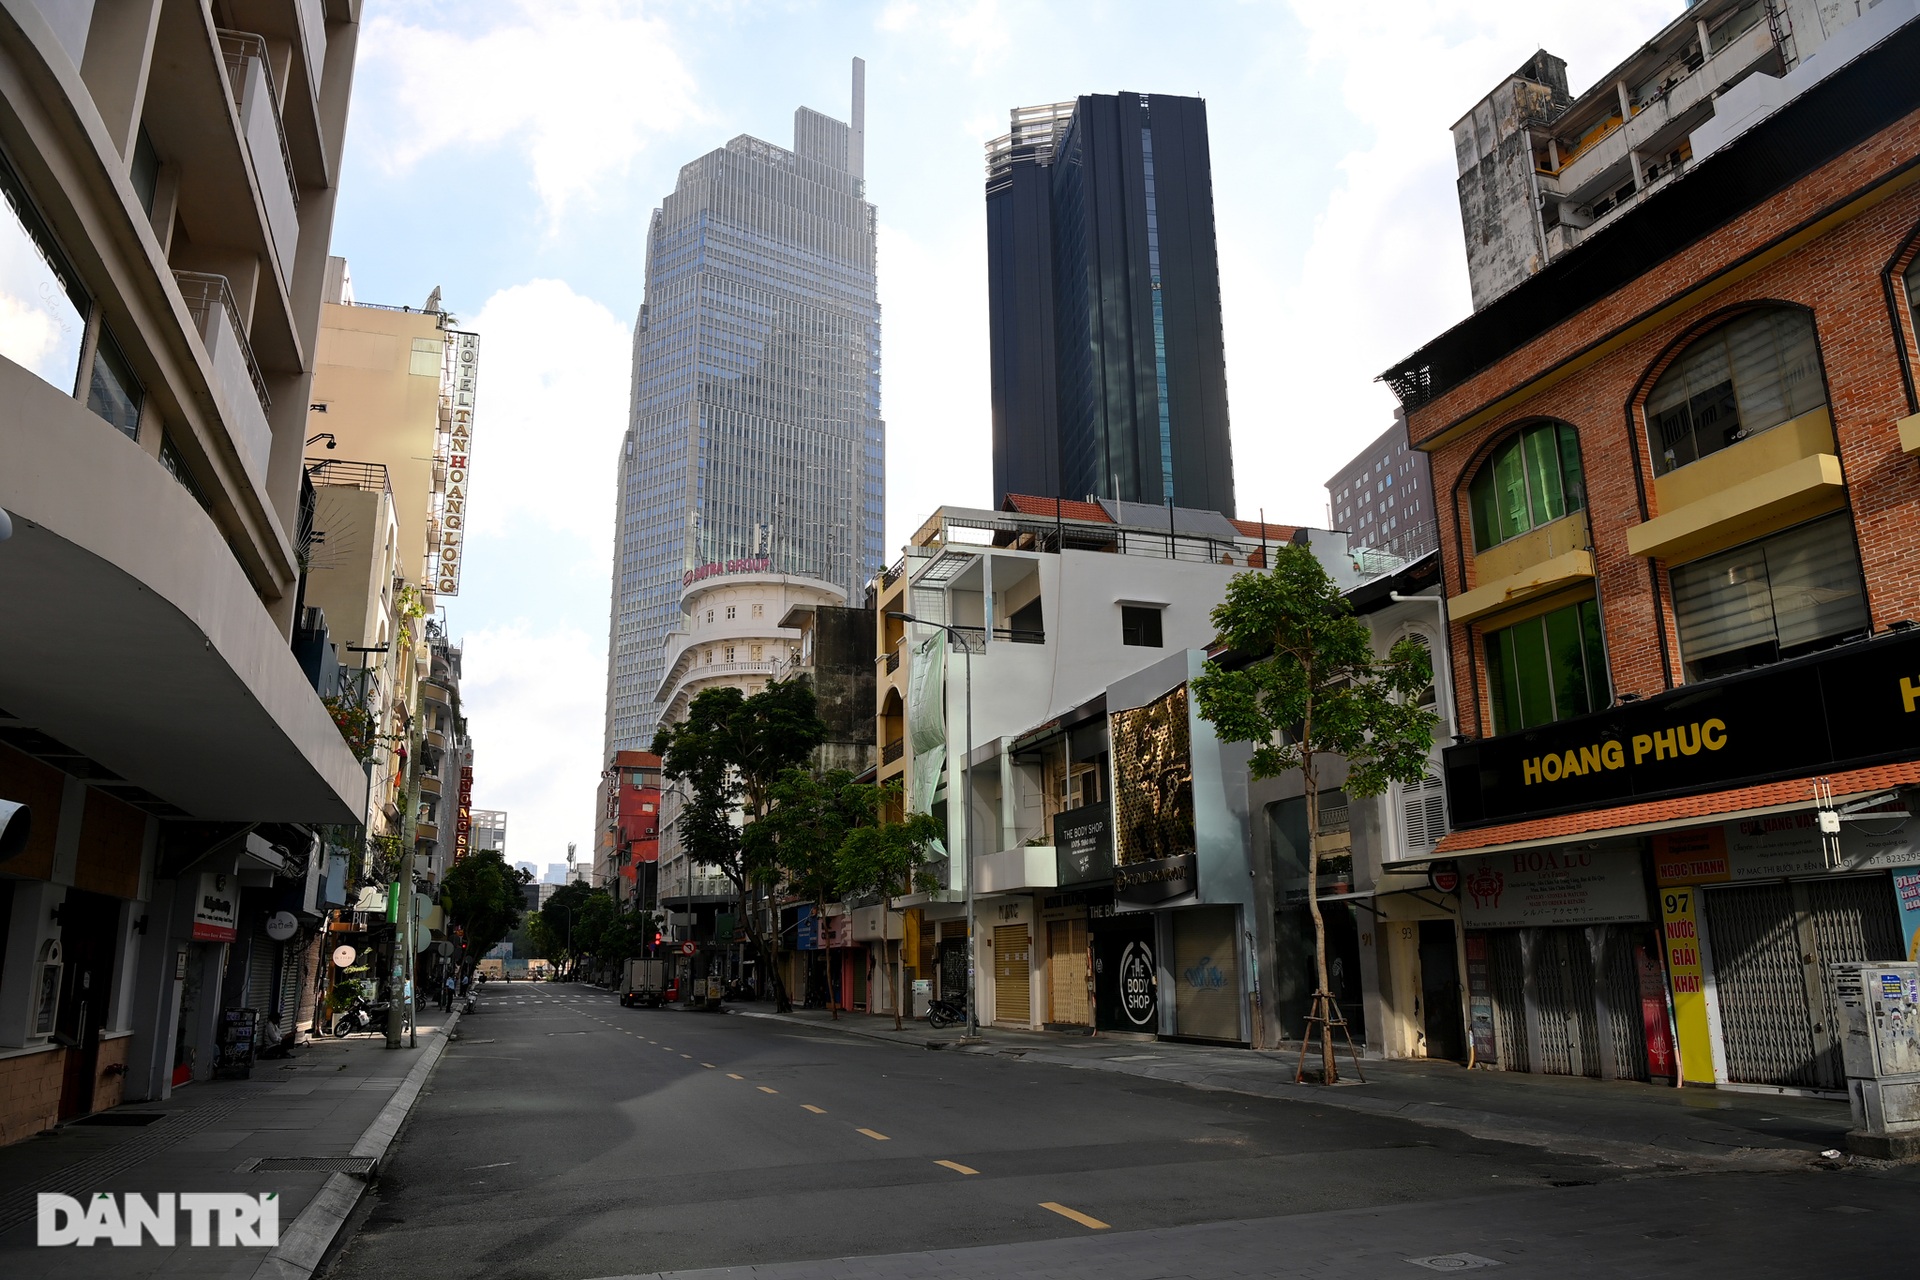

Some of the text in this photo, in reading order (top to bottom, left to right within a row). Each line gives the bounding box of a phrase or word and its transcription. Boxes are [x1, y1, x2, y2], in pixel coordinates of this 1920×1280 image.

[438, 335, 475, 593] HOTEL TAN HOANG LONG
[694, 562, 724, 579] SATRA
[728, 558, 770, 572] GROUP
[1522, 718, 1728, 786] HOANG PHUC
[1063, 829, 1073, 840] THE
[1074, 825, 1088, 838] BODY
[1512, 851, 1559, 874] HOA
[1660, 860, 1726, 879] NGỌC THANH
[1736, 868, 1745, 876] 97
[1090, 904, 1104, 919] THE
[1664, 893, 1689, 914] 97
[1666, 919, 1695, 939] NƯỚC
[1672, 944, 1696, 966] GIẢI
[1127, 978, 1150, 994] BODY
[1674, 972, 1700, 993] KHÁT
[1128, 994, 1150, 1010] SHOP
